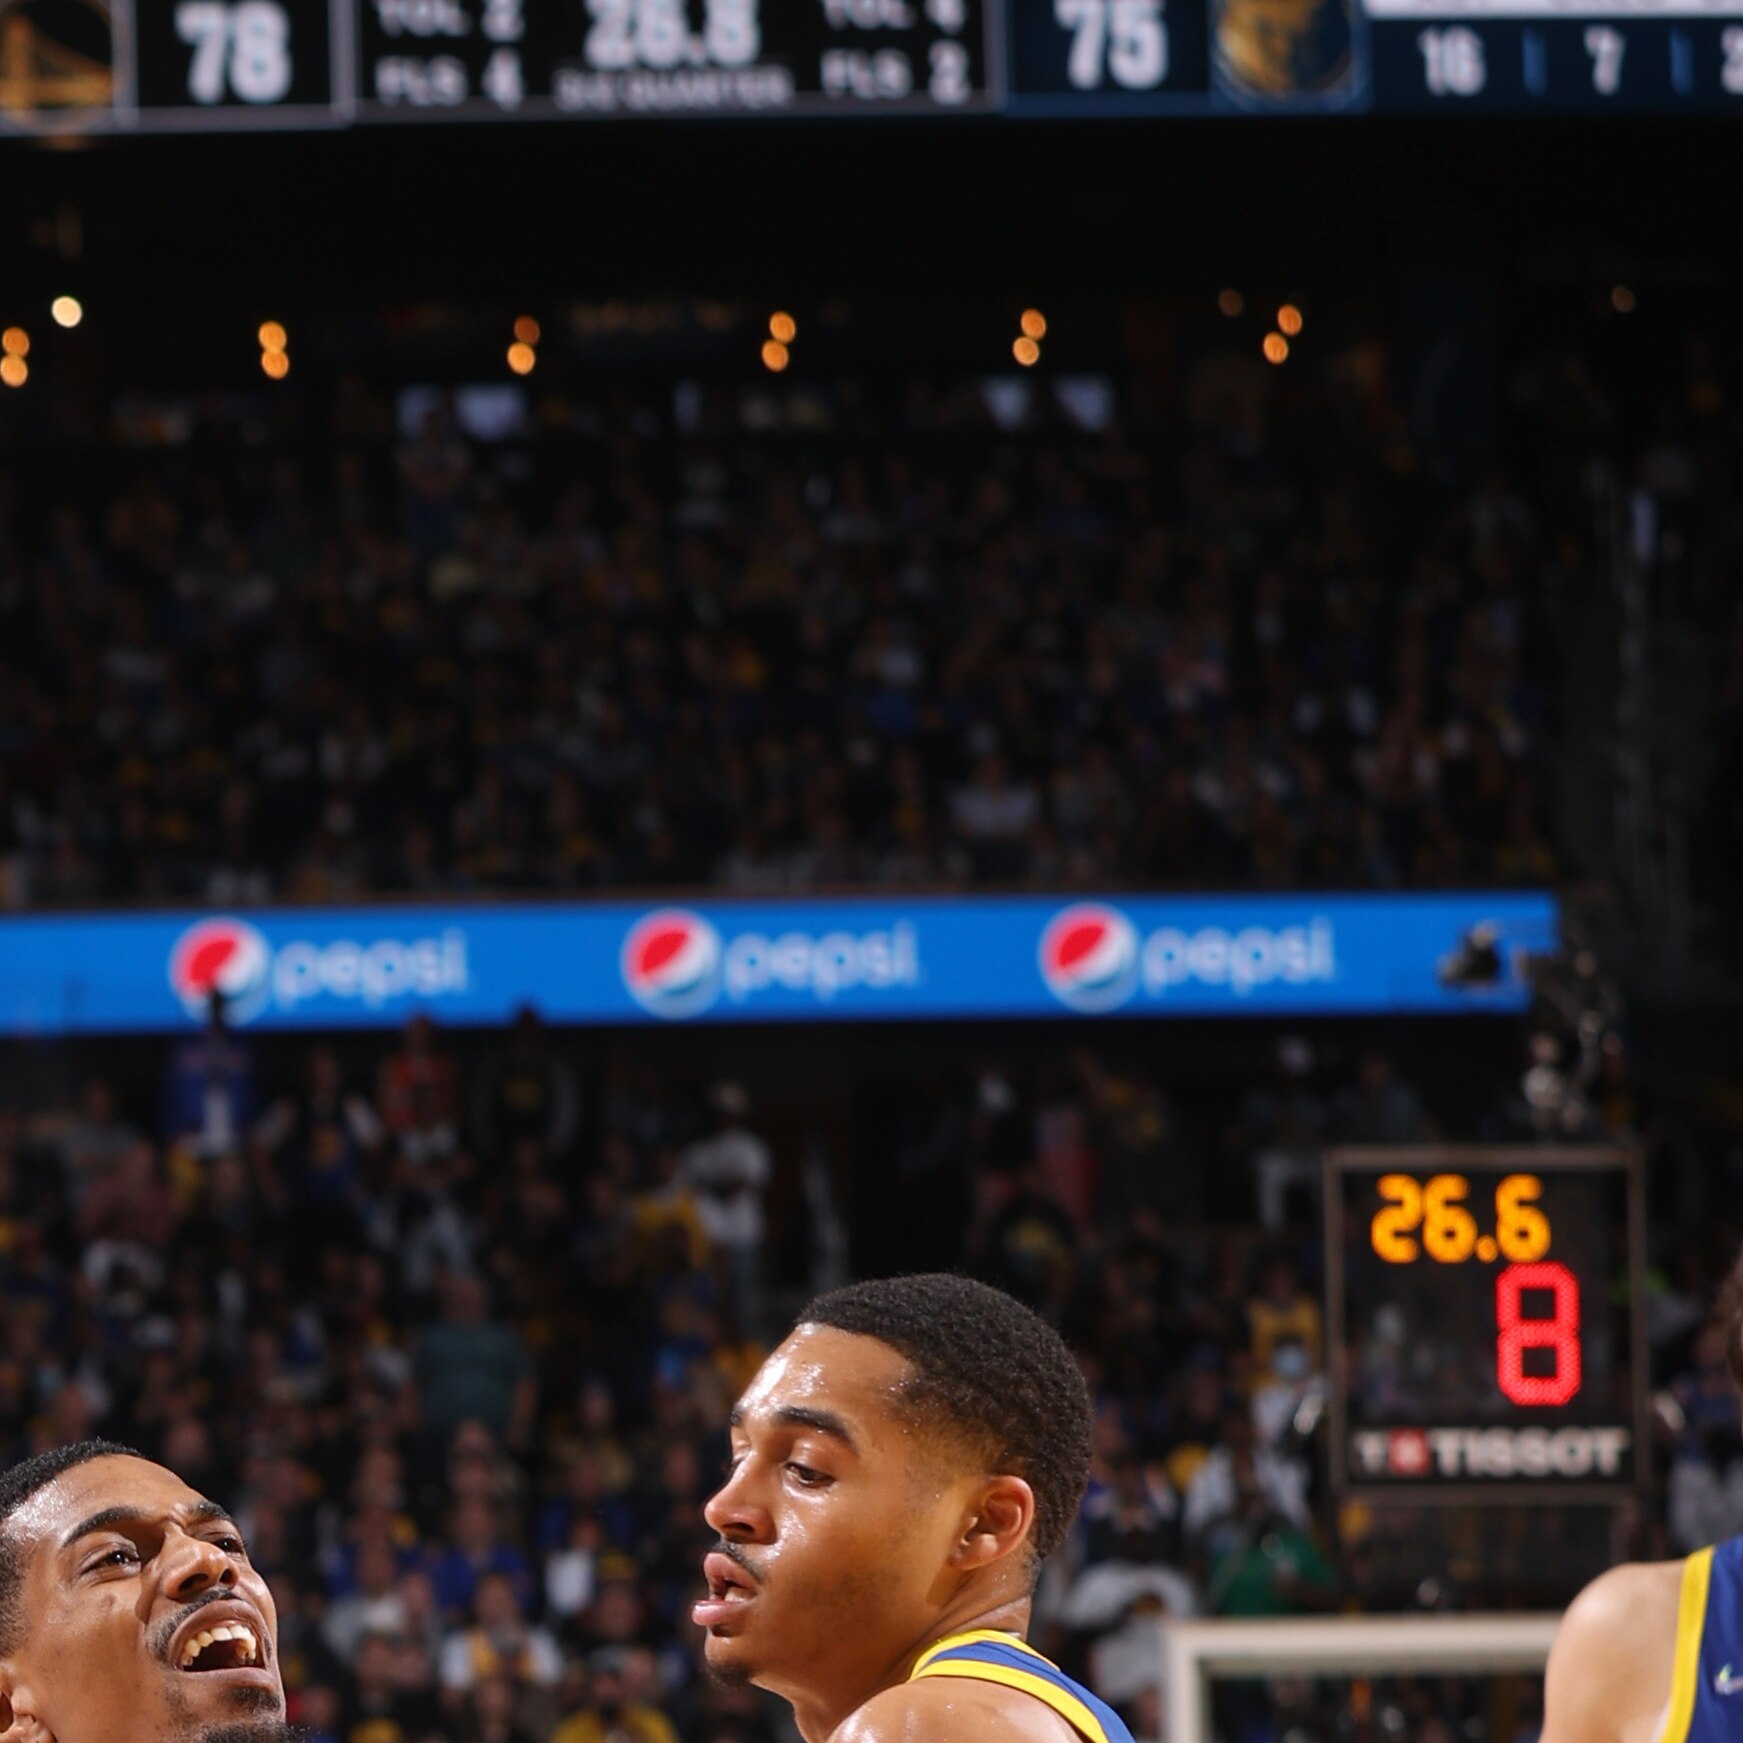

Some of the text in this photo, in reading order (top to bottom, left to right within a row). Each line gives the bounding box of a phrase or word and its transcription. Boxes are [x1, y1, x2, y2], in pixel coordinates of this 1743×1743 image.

[176, 1, 290, 103] 78
[1053, 0, 1168, 90] 75
[271, 916, 1337, 1009] pepsi pepsi pepsi
[1371, 1173, 1552, 1264] 26.6
[1495, 1261, 1582, 1406] 8
[1432, 1427, 1630, 1476] TISSOT
